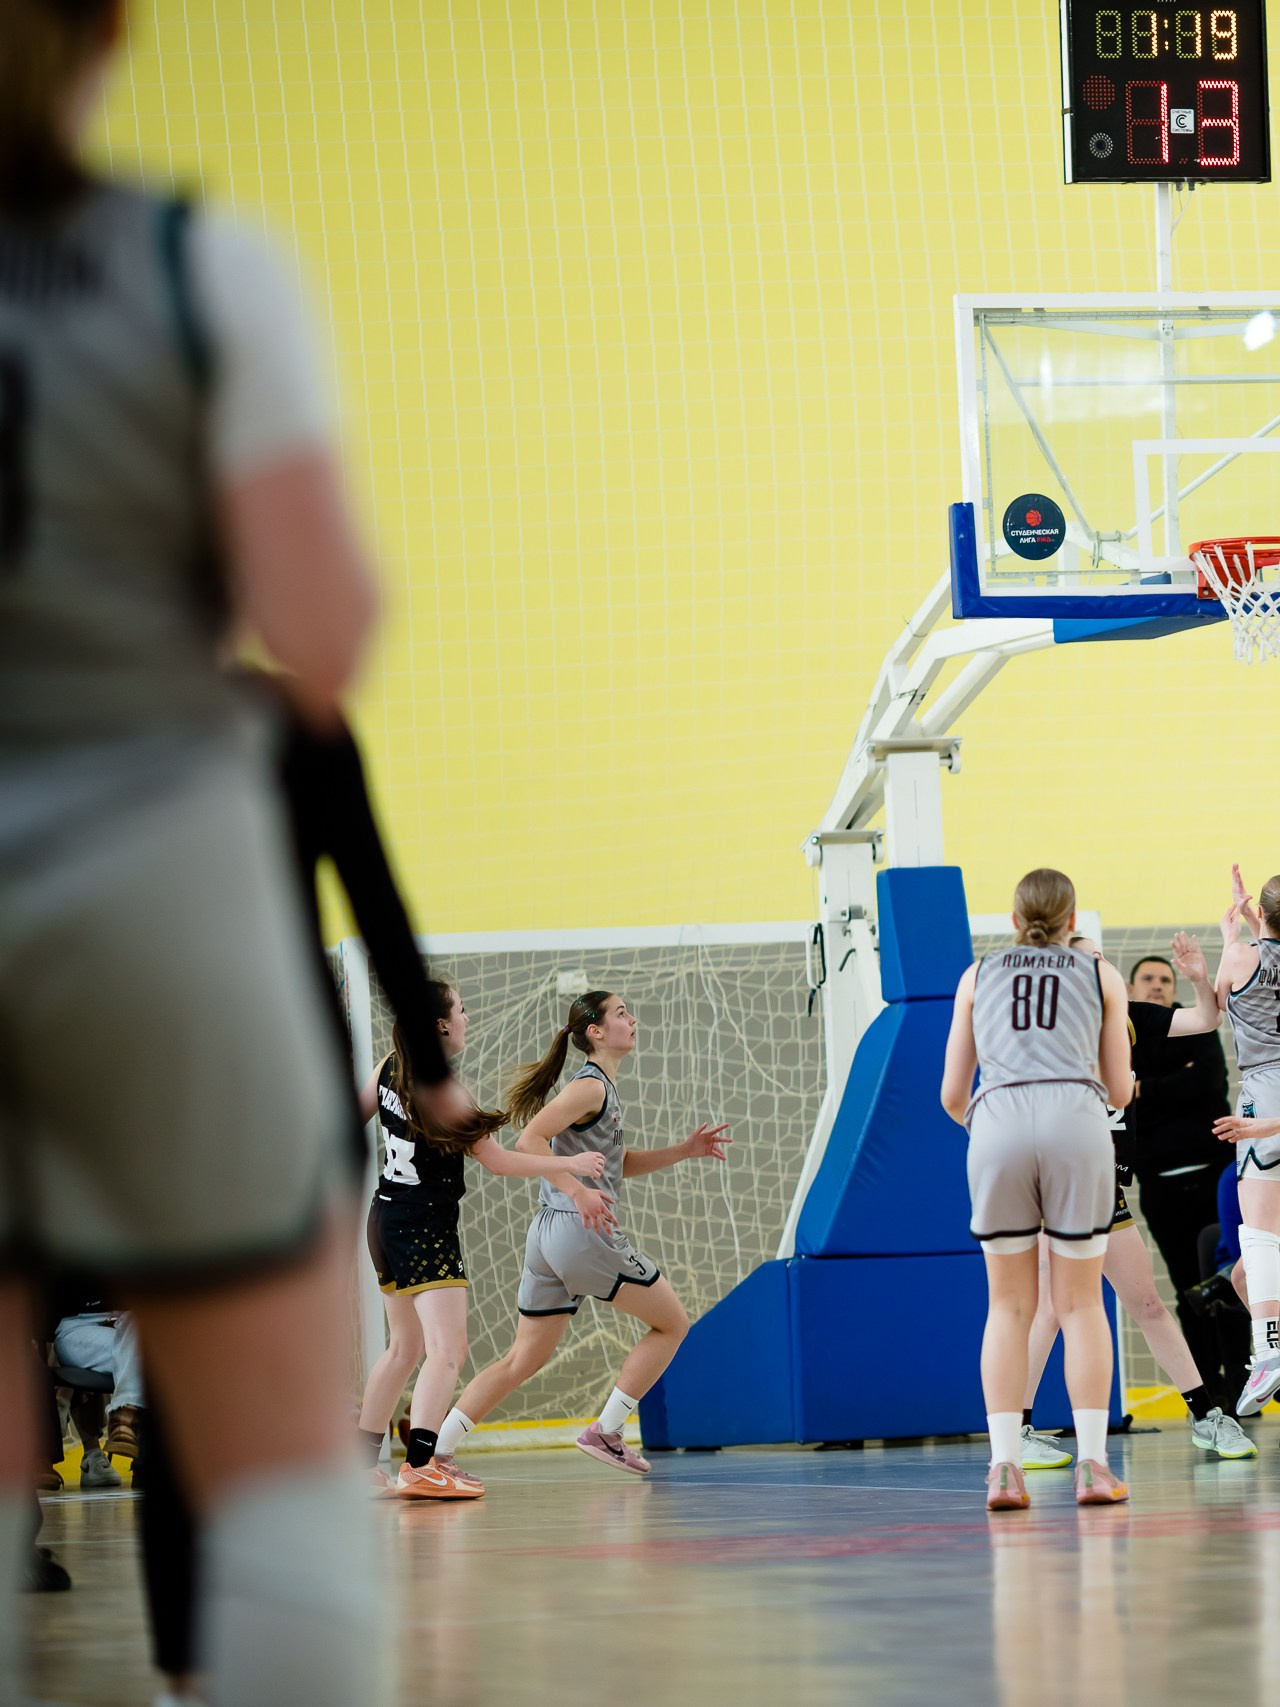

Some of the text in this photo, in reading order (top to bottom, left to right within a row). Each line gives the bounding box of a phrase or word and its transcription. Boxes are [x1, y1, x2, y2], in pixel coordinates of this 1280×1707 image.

[1150, 10, 1238, 60] 1:19
[1010, 528, 1060, 537] СТУДЕНЧЕСКАЯ
[1019, 536, 1036, 544] ЛИГА
[1011, 973, 1060, 1031] 80
